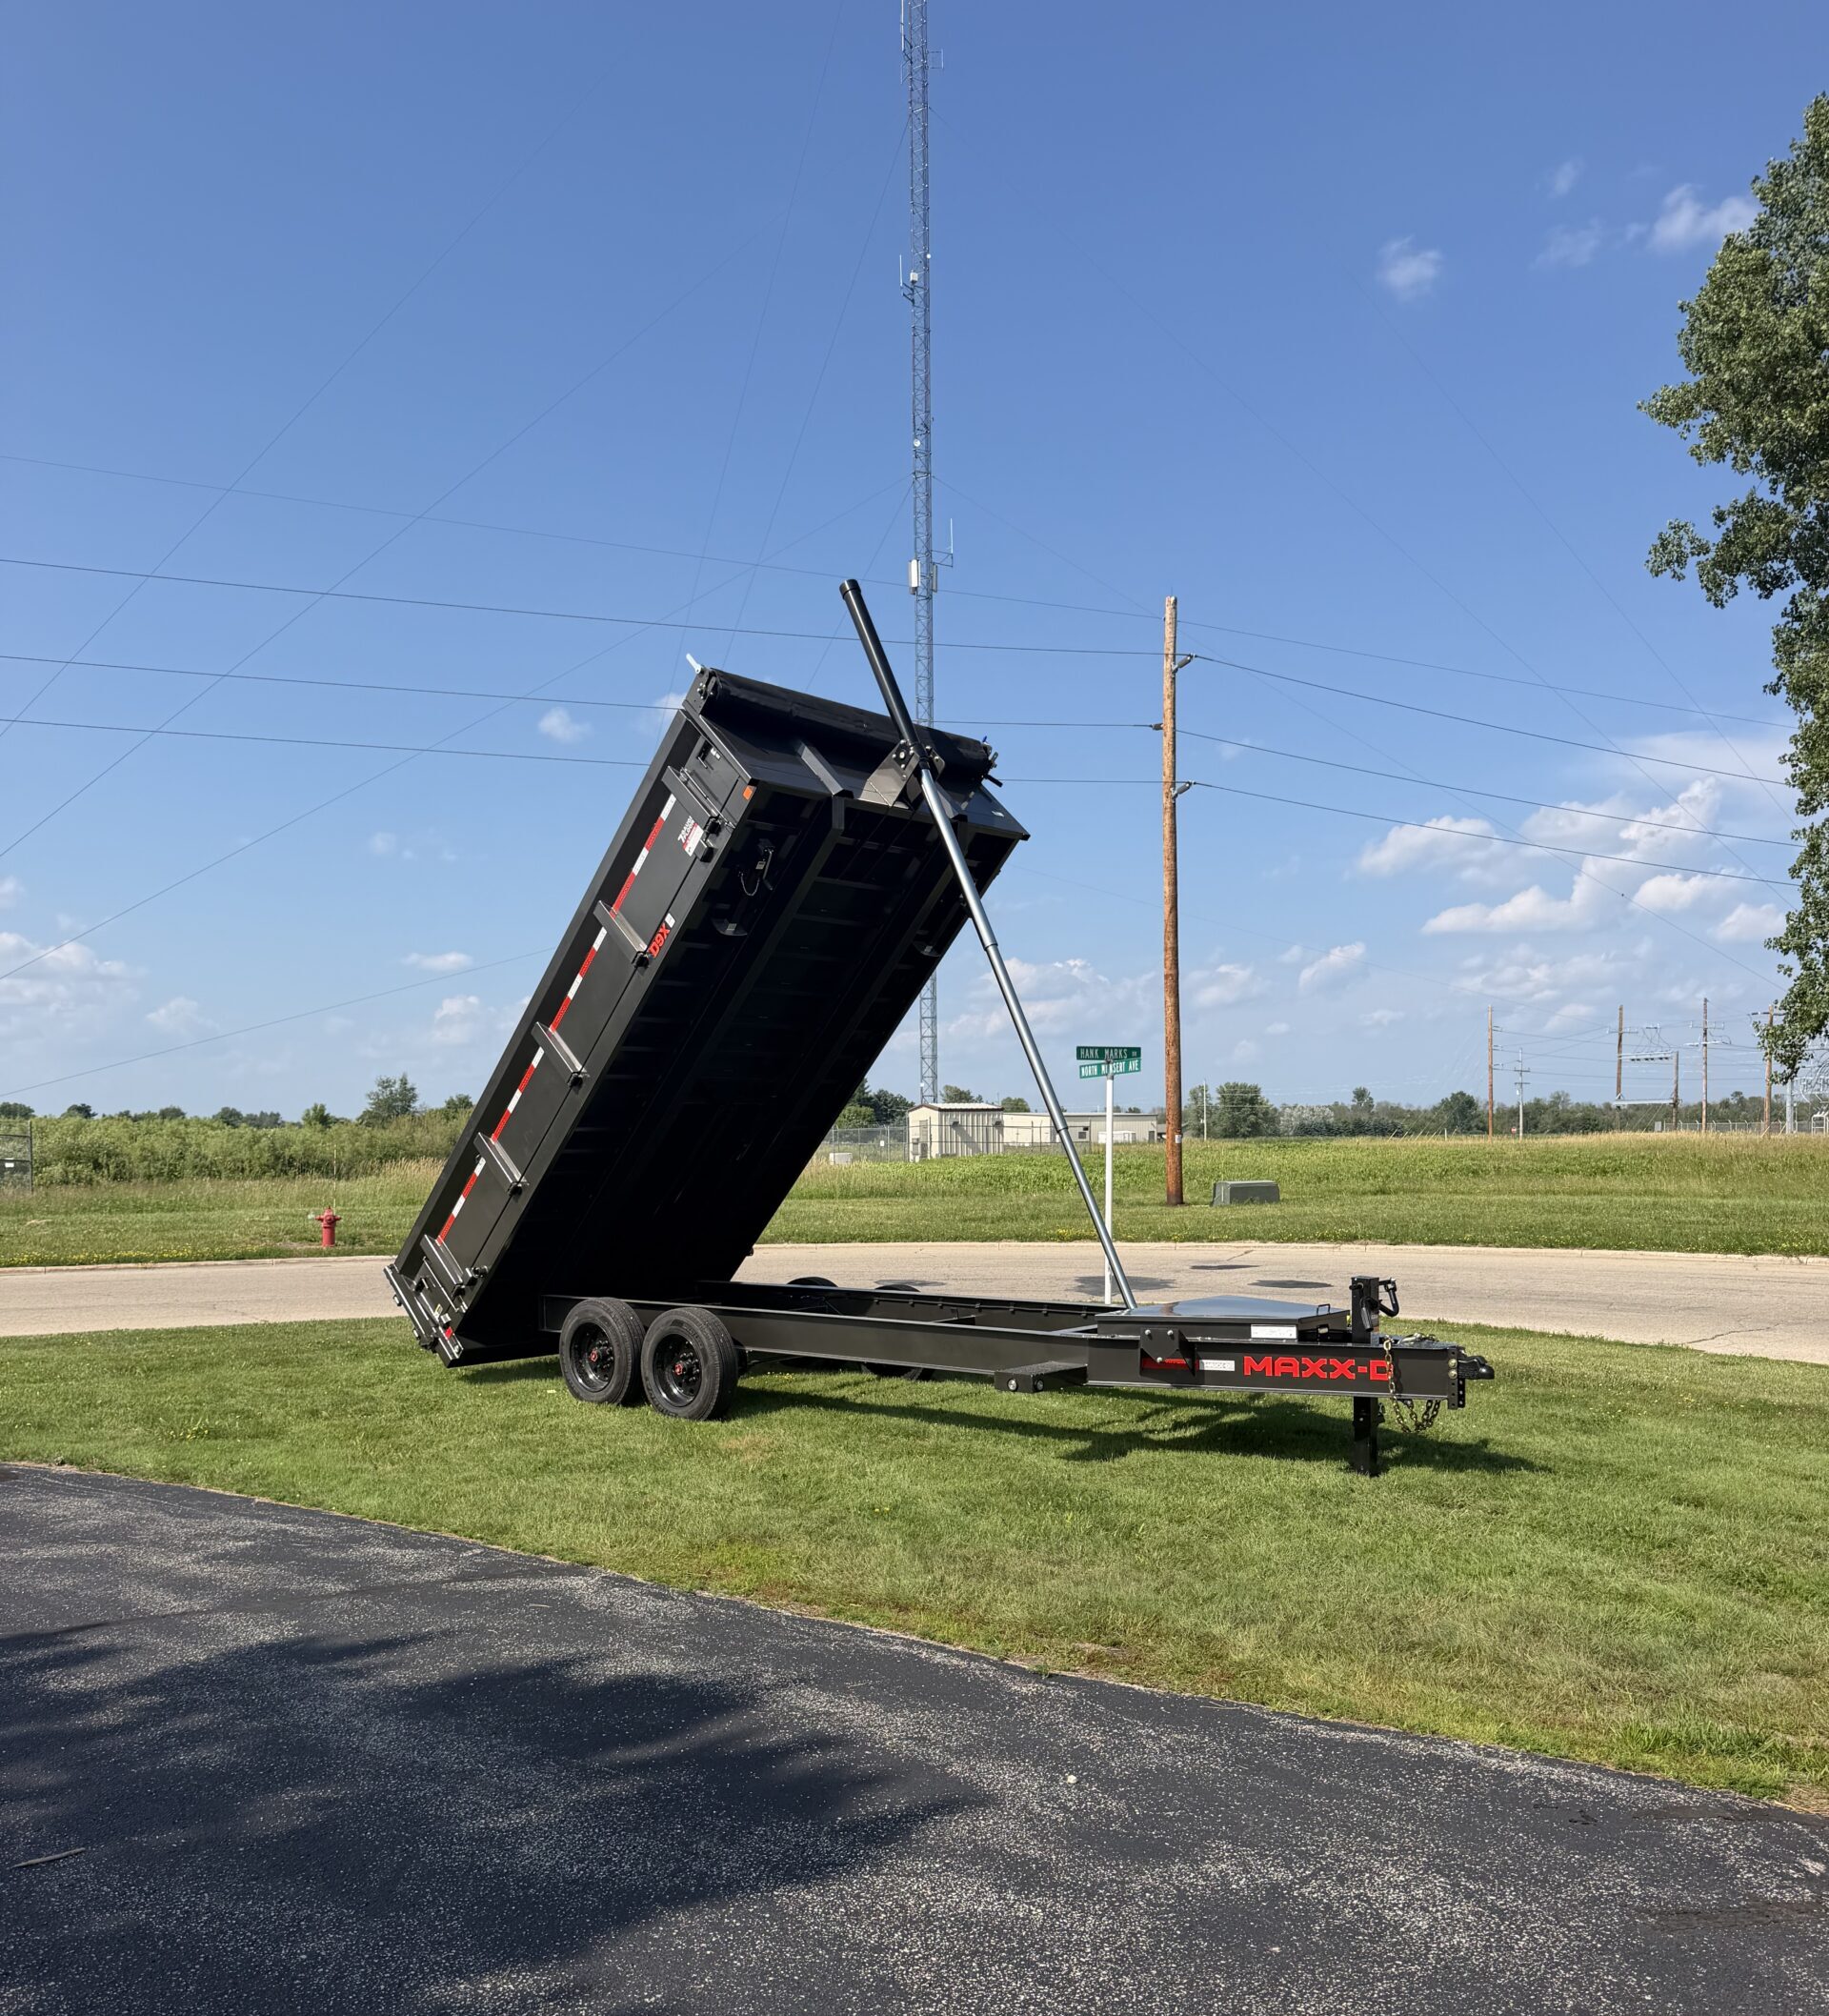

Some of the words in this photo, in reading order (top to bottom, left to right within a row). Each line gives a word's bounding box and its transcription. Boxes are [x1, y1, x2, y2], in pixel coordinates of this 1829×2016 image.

[648, 922, 671, 959] D9X
[1080, 1048, 1098, 1058] HANK
[1104, 1048, 1128, 1059] MARKS
[1081, 1065, 1097, 1077] NORTH
[1129, 1059, 1139, 1072] AVE
[1243, 1356, 1394, 1381] MAXX-D
